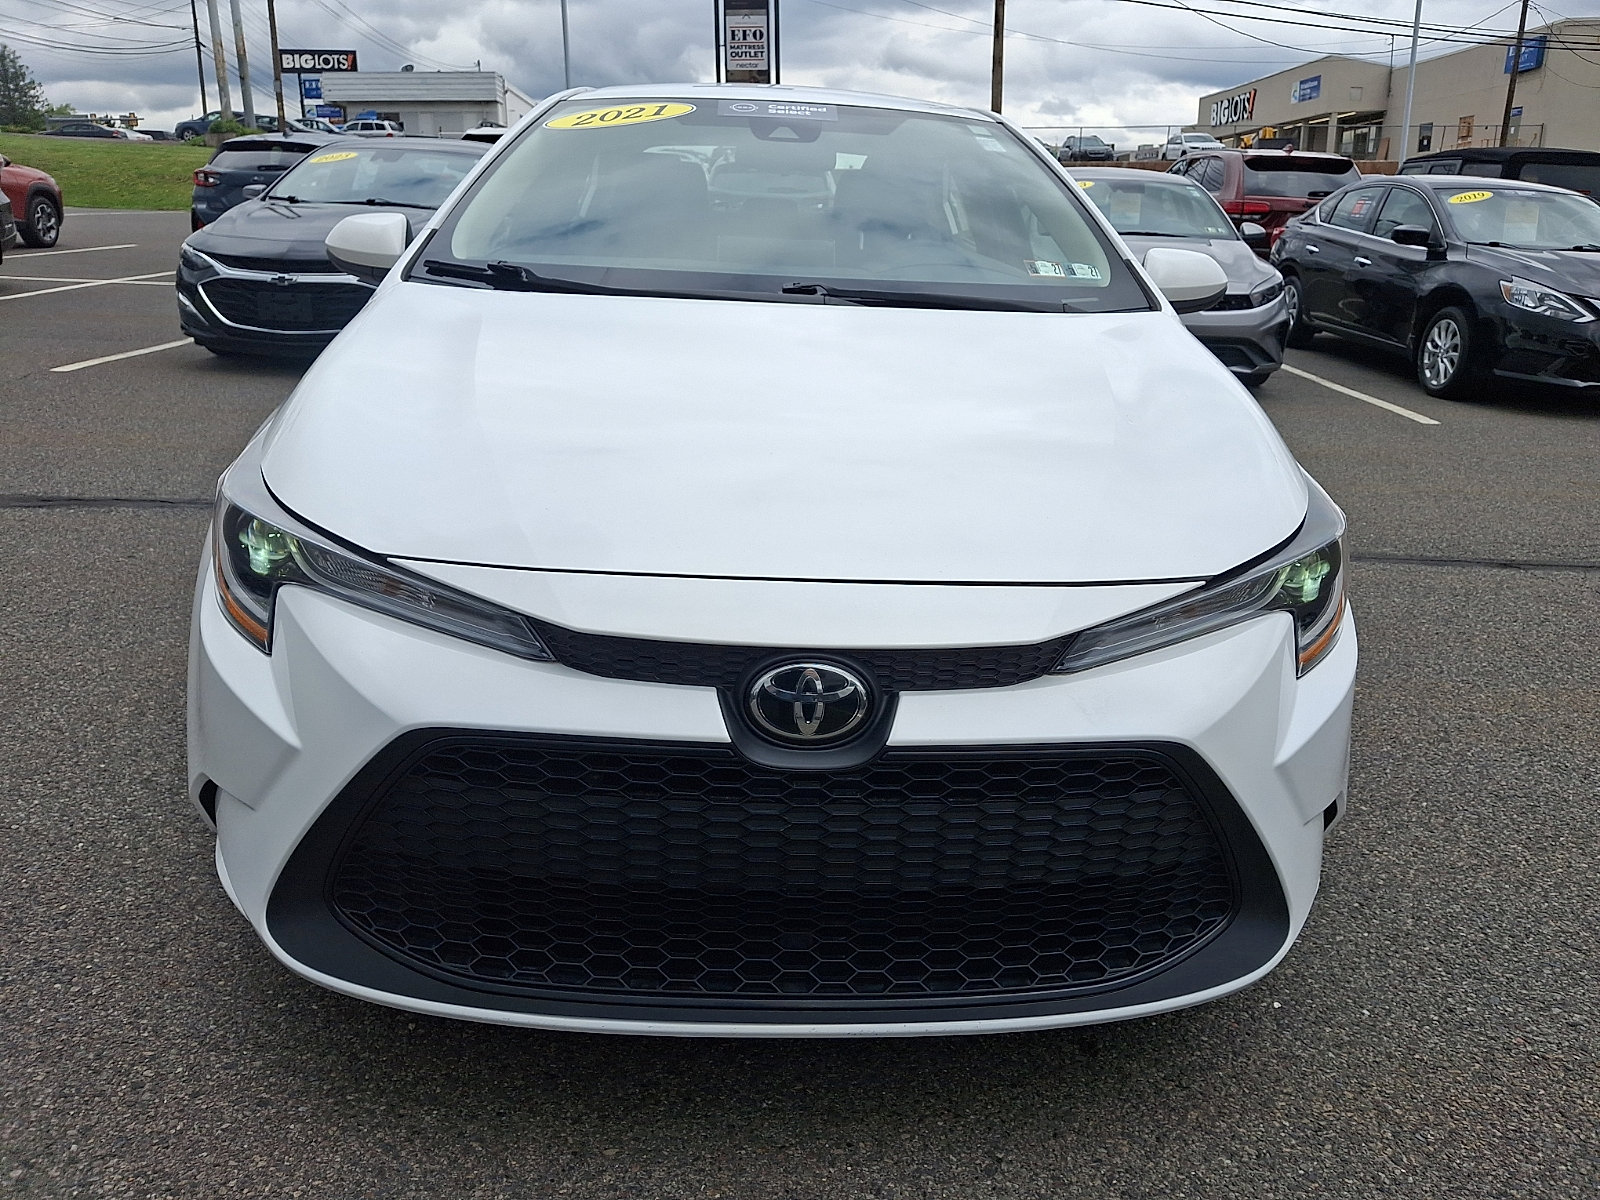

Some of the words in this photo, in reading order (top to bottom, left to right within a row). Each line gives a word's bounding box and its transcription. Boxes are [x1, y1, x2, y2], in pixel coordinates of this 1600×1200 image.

[730, 29, 764, 41] EFO
[768, 104, 827, 112] Certified
[571, 104, 669, 127] 2021
[1457, 191, 1485, 202] 2019
